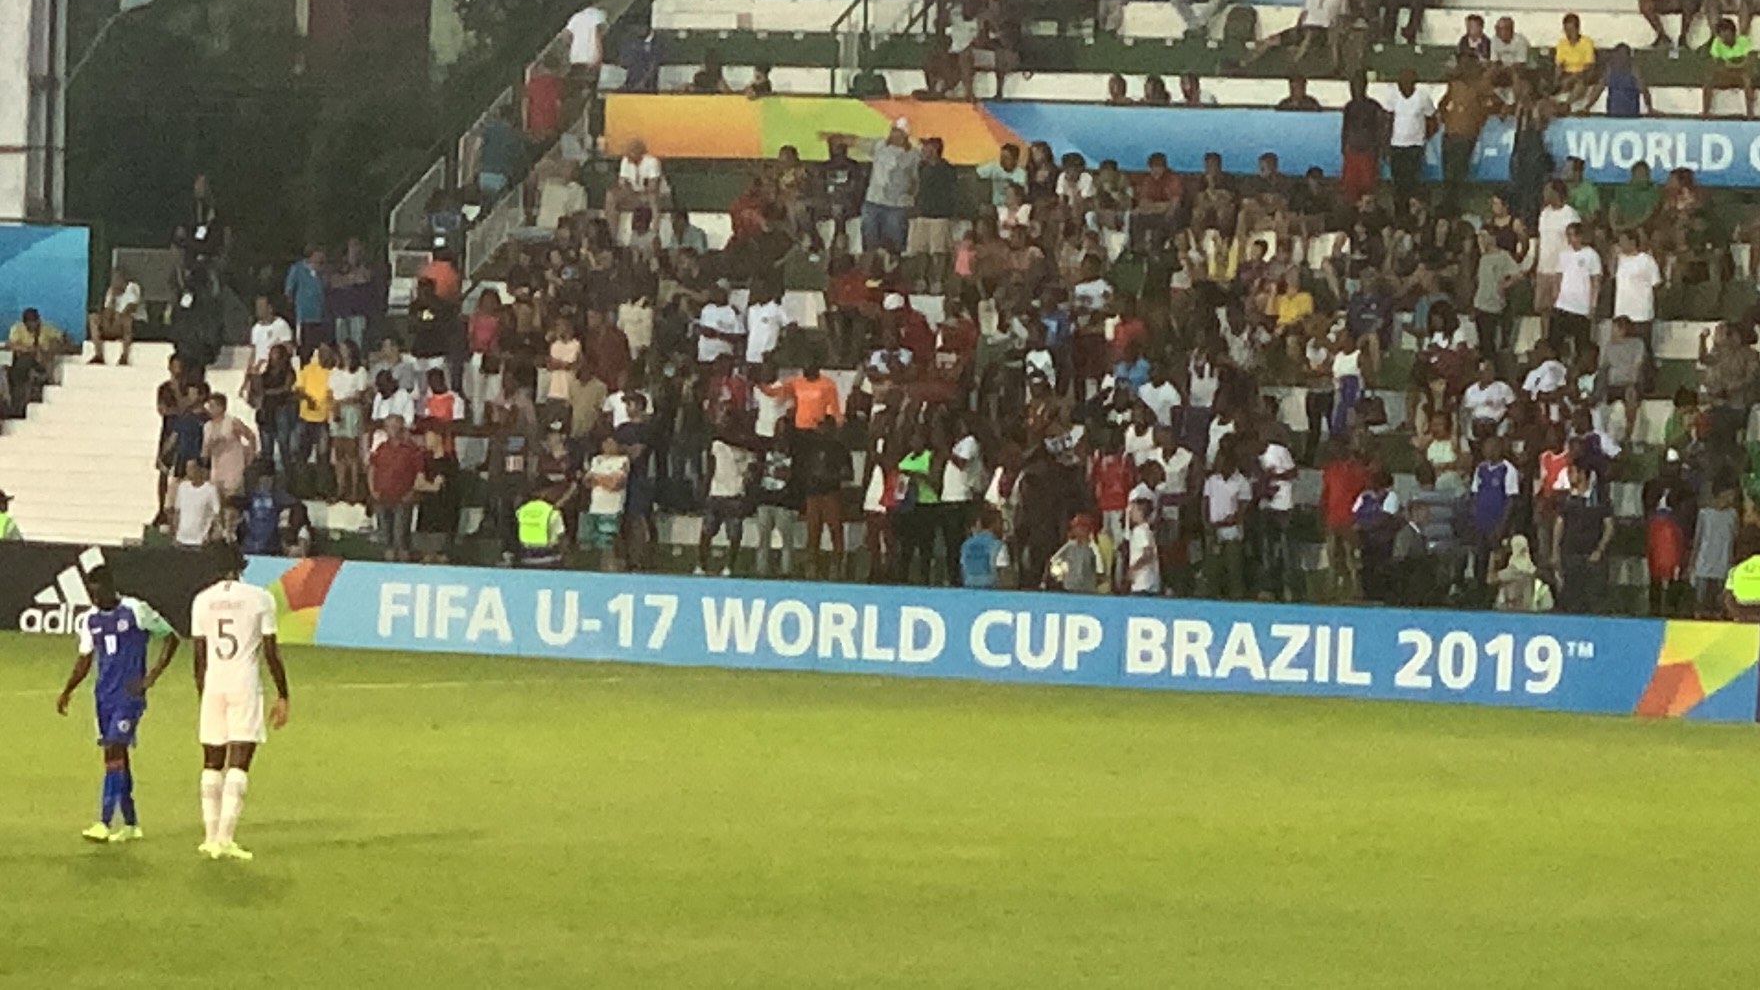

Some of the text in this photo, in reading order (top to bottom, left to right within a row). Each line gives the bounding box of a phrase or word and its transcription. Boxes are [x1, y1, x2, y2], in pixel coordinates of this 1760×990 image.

[1565, 129, 1734, 171] WORLD
[215, 618, 239, 661] 5
[377, 581, 514, 643] FIFA
[535, 588, 679, 650] U-17
[701, 596, 947, 663] WORLD
[970, 609, 1103, 671] CUP
[1125, 616, 1373, 686] BRAZIL
[1393, 629, 1563, 694] 2019
